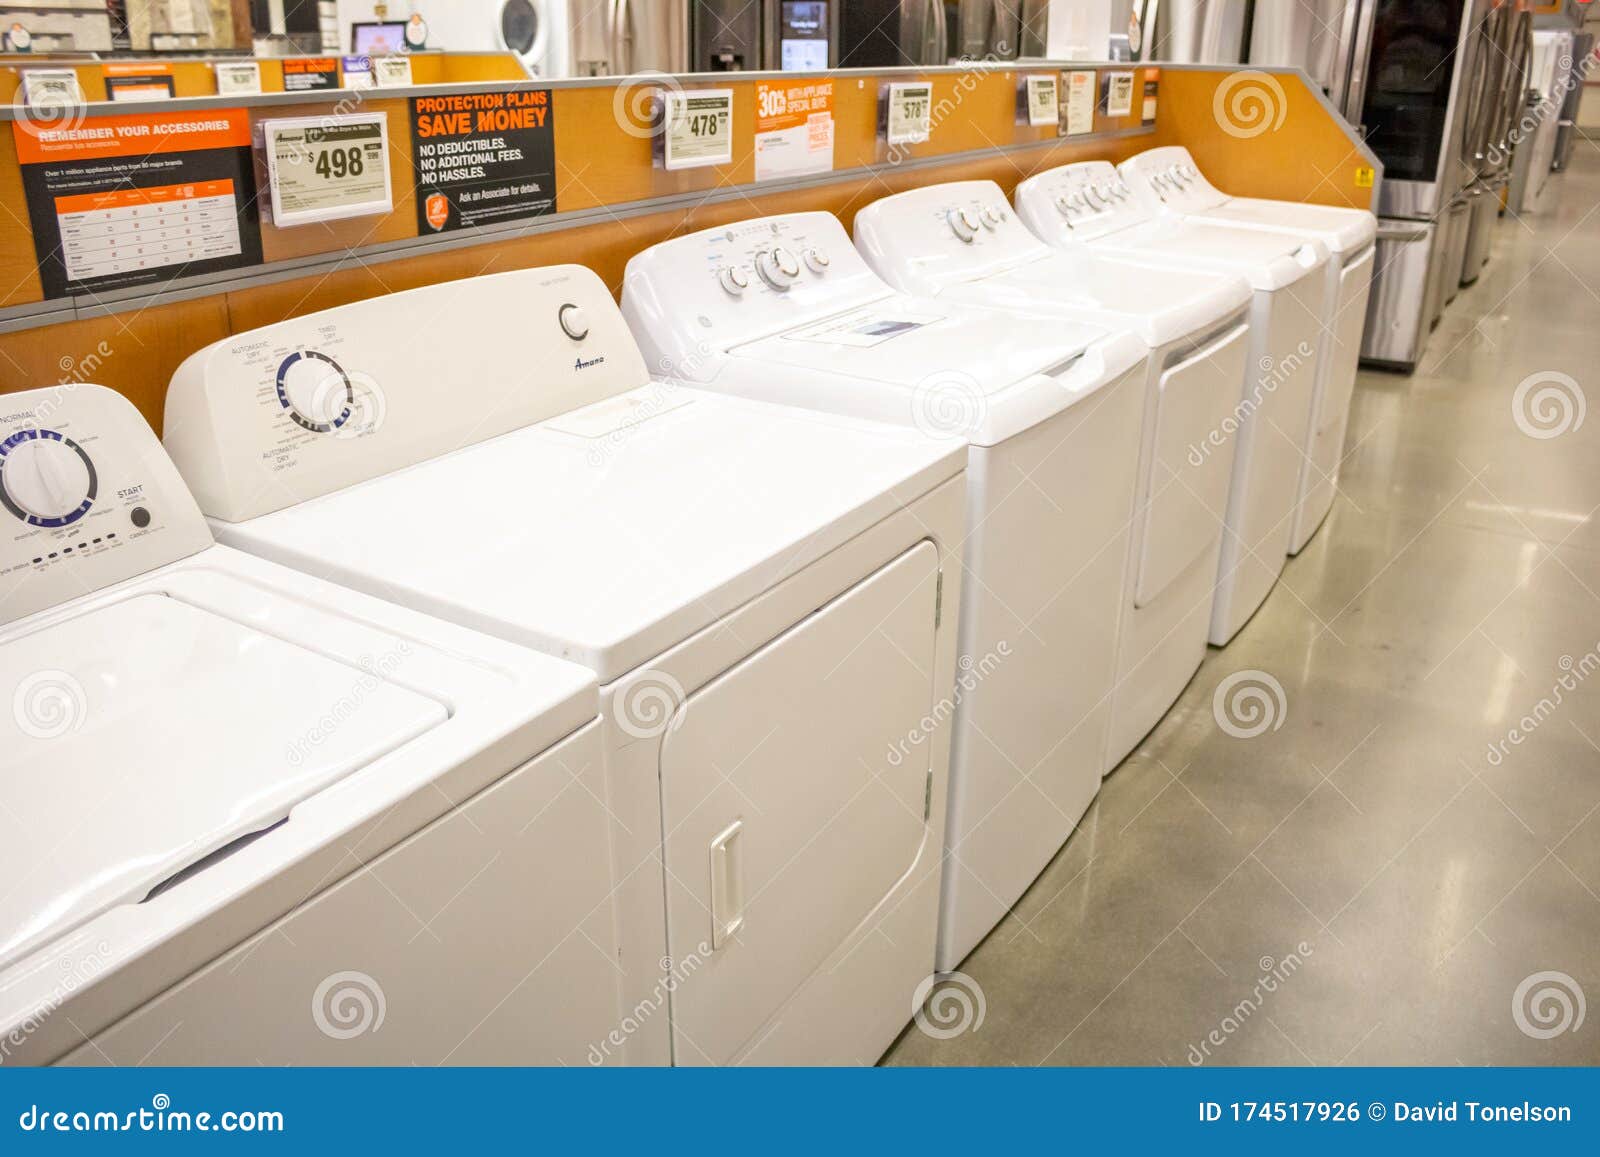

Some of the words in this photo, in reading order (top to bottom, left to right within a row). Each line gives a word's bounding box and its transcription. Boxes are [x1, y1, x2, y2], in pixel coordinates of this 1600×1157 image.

[416, 94, 503, 113] PROTECTION
[507, 91, 547, 106] PLANS
[39, 127, 114, 143] REMEMBER
[117, 123, 150, 137] YOUR
[153, 120, 230, 135] ACCESSORIES
[417, 112, 472, 137] SAVE
[477, 107, 548, 132] MONEY
[419, 144, 435, 157] NO
[437, 138, 507, 155] DEDUCTIBLES.
[420, 158, 436, 171] NO
[438, 151, 497, 168] ADDITIONAL
[497, 149, 524, 161] FEES.
[85, 166, 112, 174] appliance
[421, 172, 437, 184] NO
[439, 166, 487, 181] HASSLES.
[459, 192, 471, 202] Ask
[472, 192, 481, 200] an
[481, 188, 510, 199] Associate
[510, 185, 520, 194] for
[520, 182, 541, 194] details.
[575, 357, 604, 371] Amana
[0, 411, 36, 423] NORMAL
[117, 485, 143, 498] START
